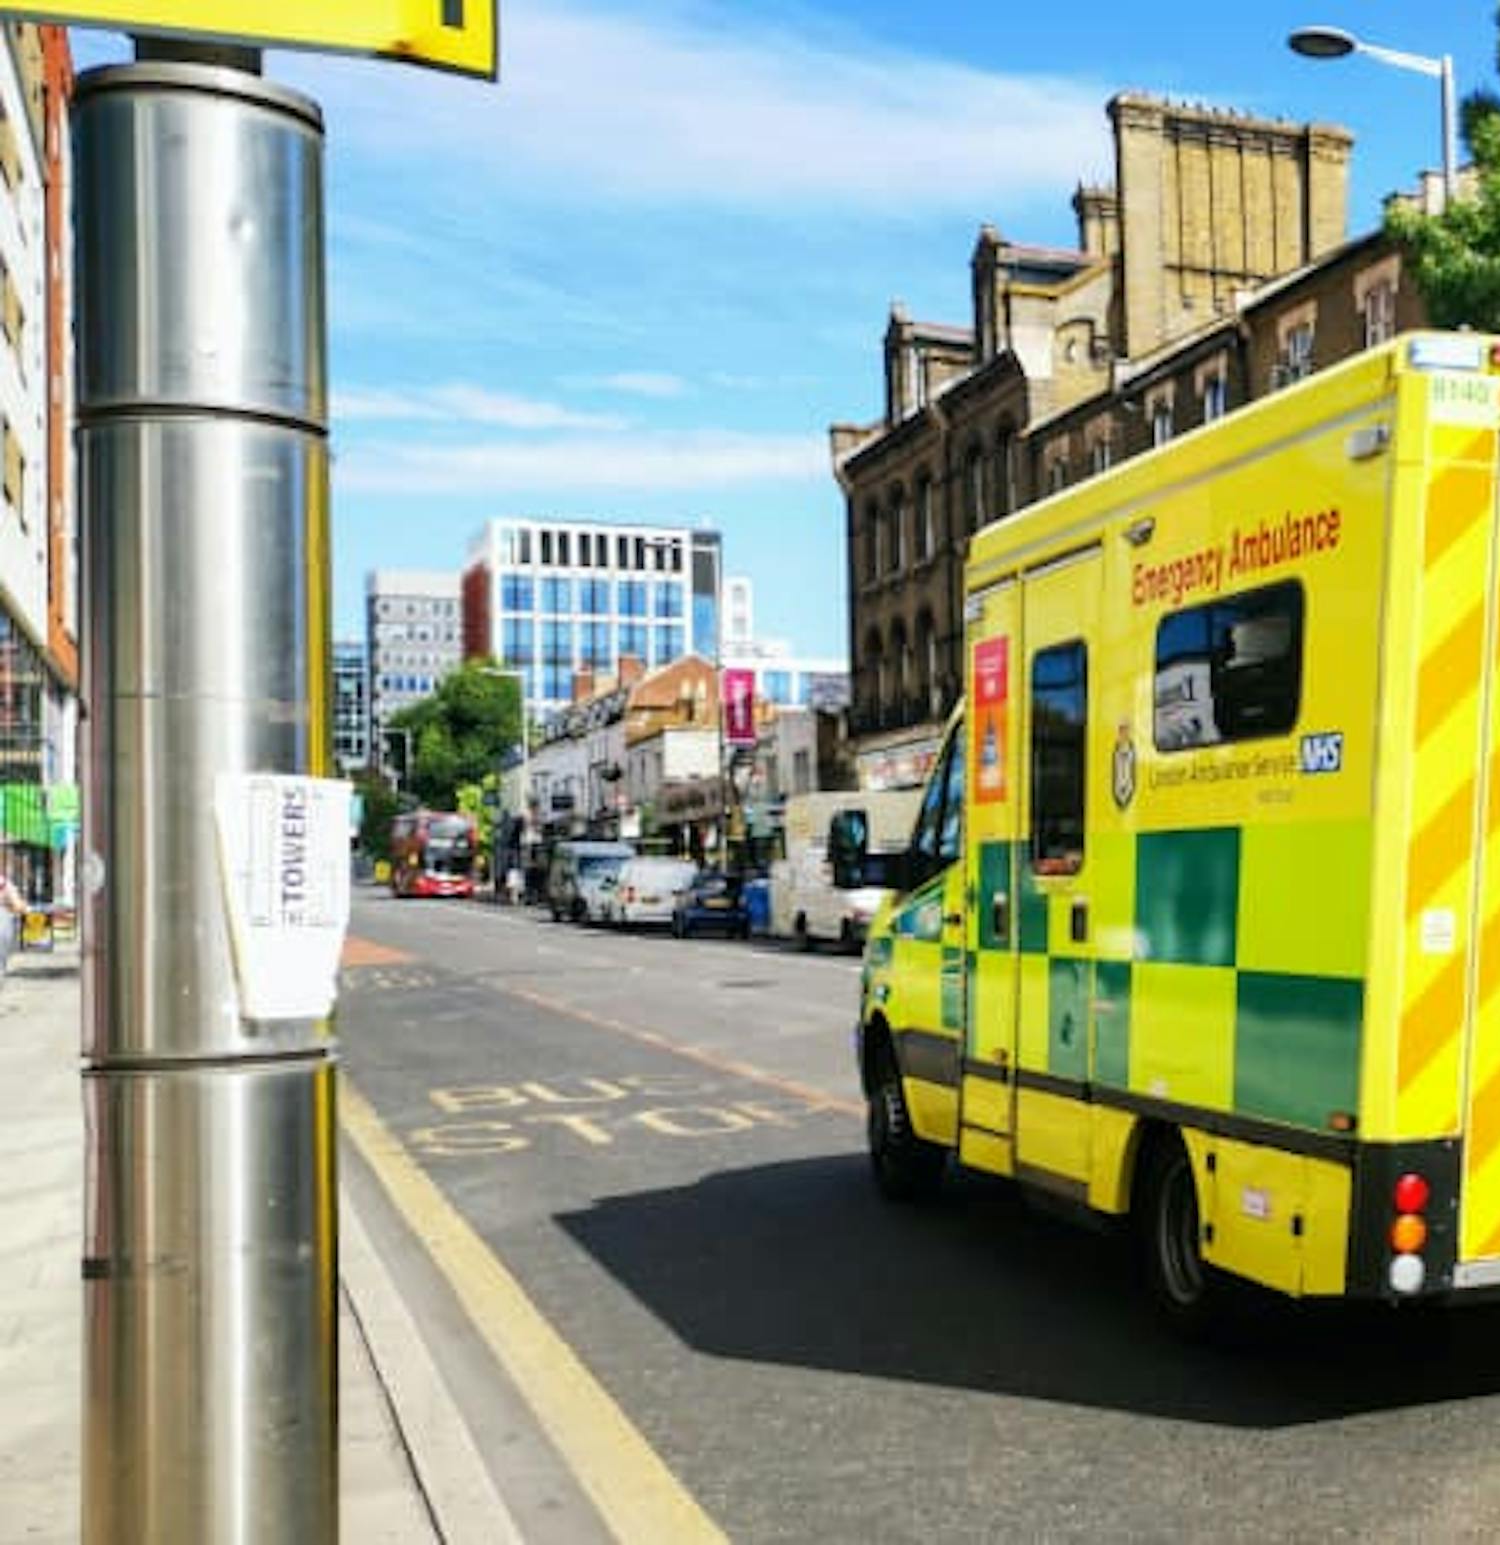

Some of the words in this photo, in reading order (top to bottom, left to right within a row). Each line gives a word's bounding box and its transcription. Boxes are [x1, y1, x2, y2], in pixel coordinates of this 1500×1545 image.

[1132, 548, 1223, 605] Emergency
[1229, 508, 1341, 579] Ambulance
[1302, 735, 1342, 772] NHS
[280, 785, 307, 905] TOWERS
[429, 1074, 695, 1113] BUS
